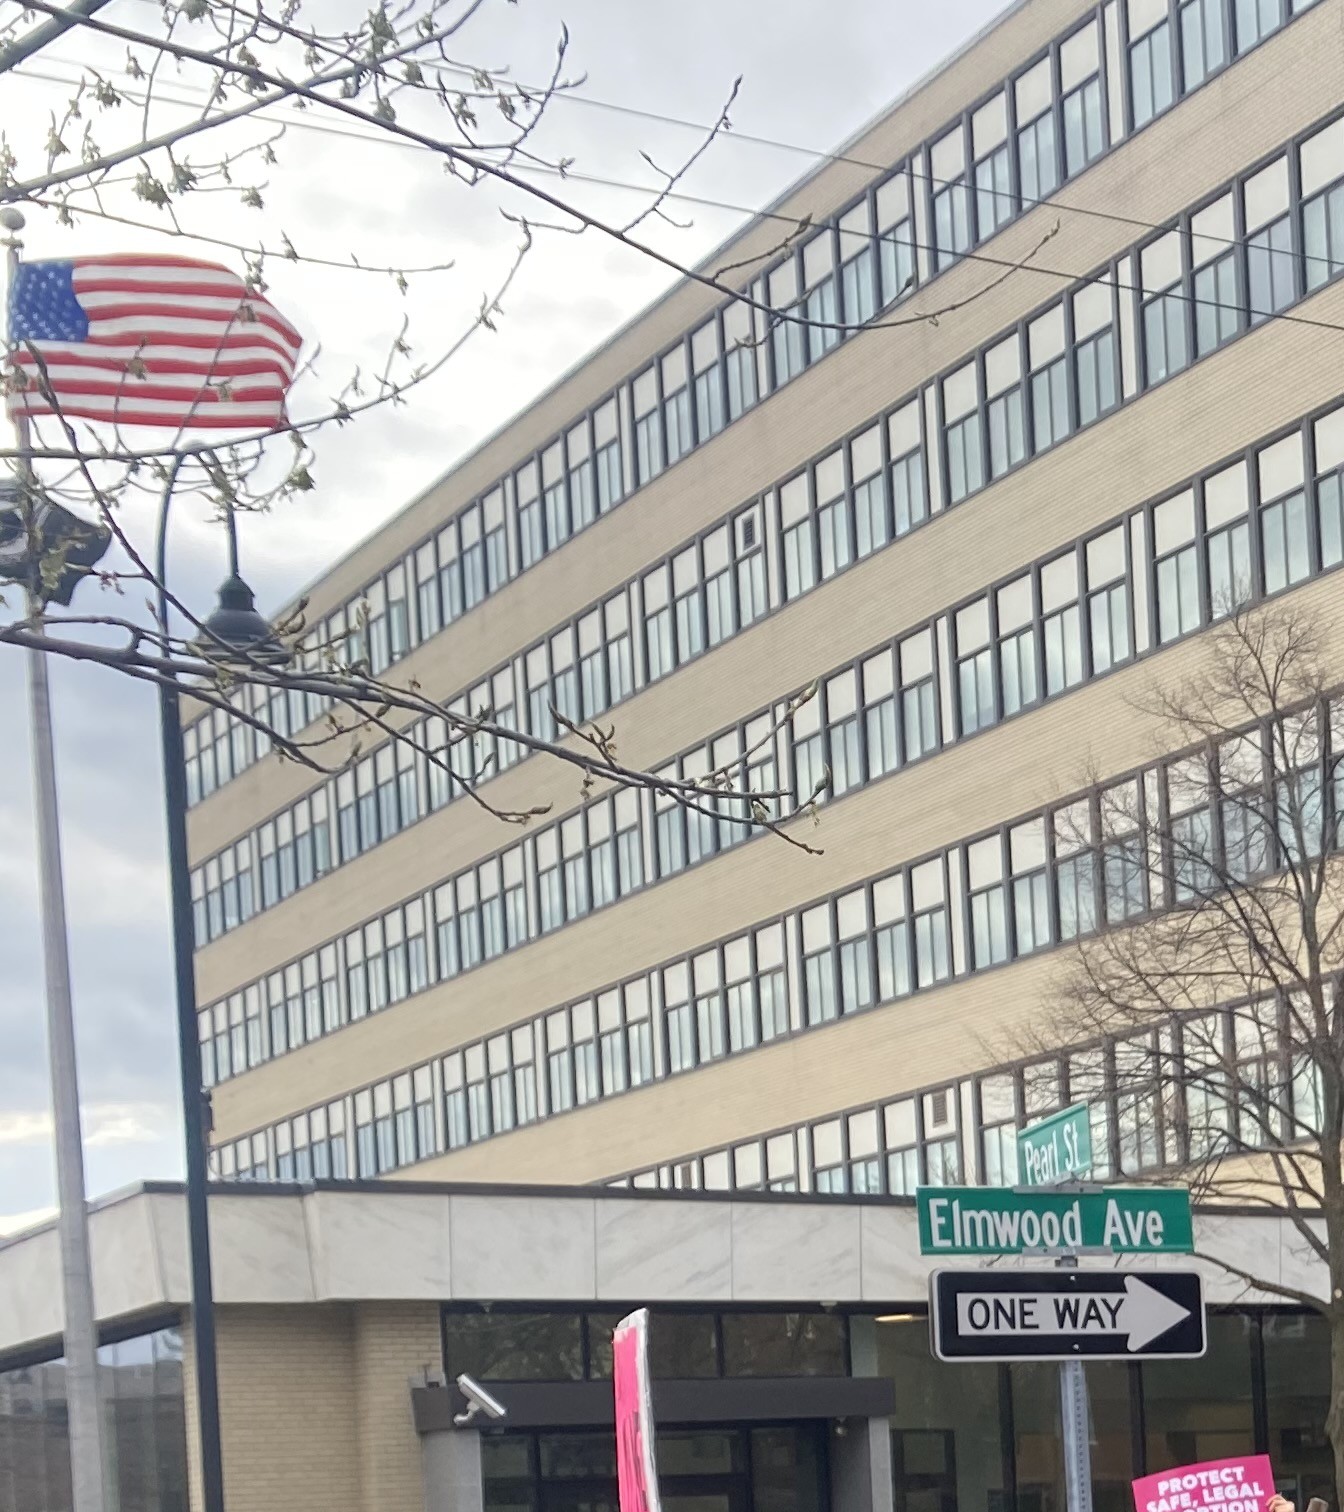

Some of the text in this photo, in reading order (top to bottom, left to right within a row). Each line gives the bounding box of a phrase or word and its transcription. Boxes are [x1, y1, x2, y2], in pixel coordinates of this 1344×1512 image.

[1024, 1120, 1080, 1186] Pearl St
[929, 1198, 1163, 1247] Elmwood Ave
[968, 1298, 1124, 1330] ONE WAY
[1157, 1466, 1244, 1496] PROTECT
[1203, 1482, 1264, 1503] LEGAL
